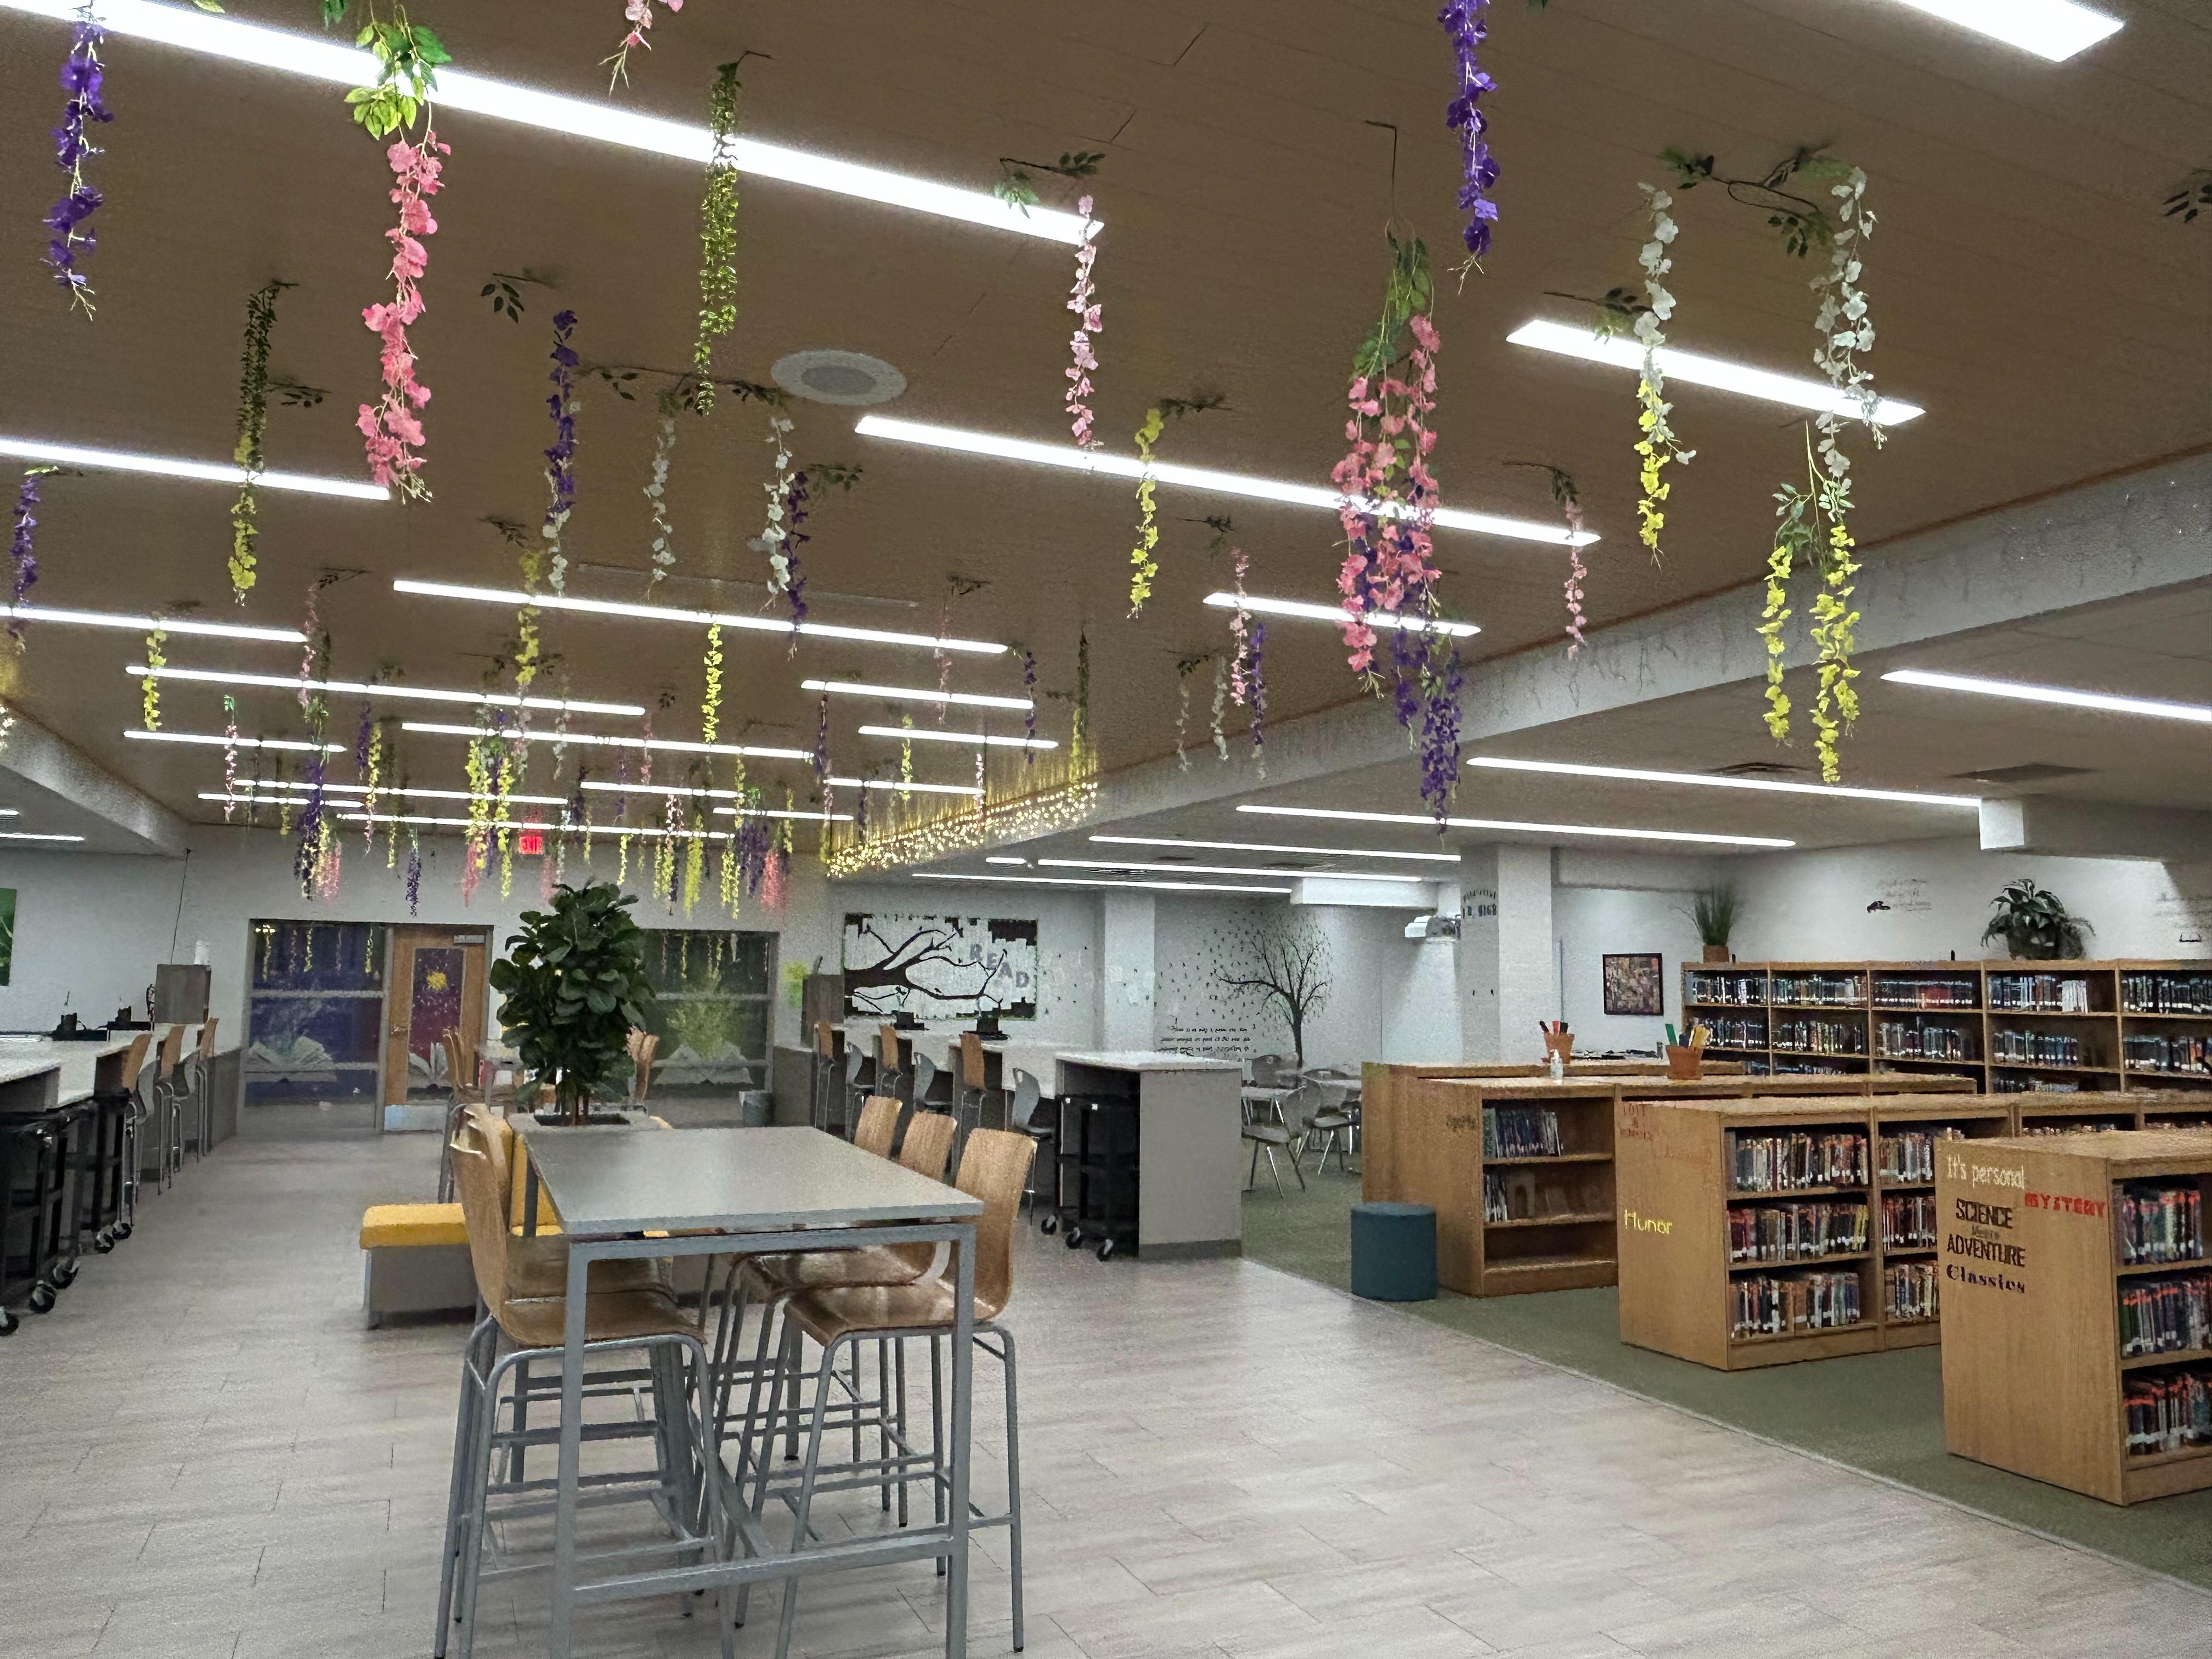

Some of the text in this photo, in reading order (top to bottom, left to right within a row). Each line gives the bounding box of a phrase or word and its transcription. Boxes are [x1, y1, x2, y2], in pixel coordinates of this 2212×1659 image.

[969, 944, 1030, 988] READ
[1948, 1154, 2025, 1190] It's personal
[1956, 1198, 2013, 1229] SCIENCE
[2024, 1193, 2106, 1217] MYSTERY
[1947, 1233, 2026, 1267] ADVENTURE
[1946, 1263, 2025, 1294] Classics
